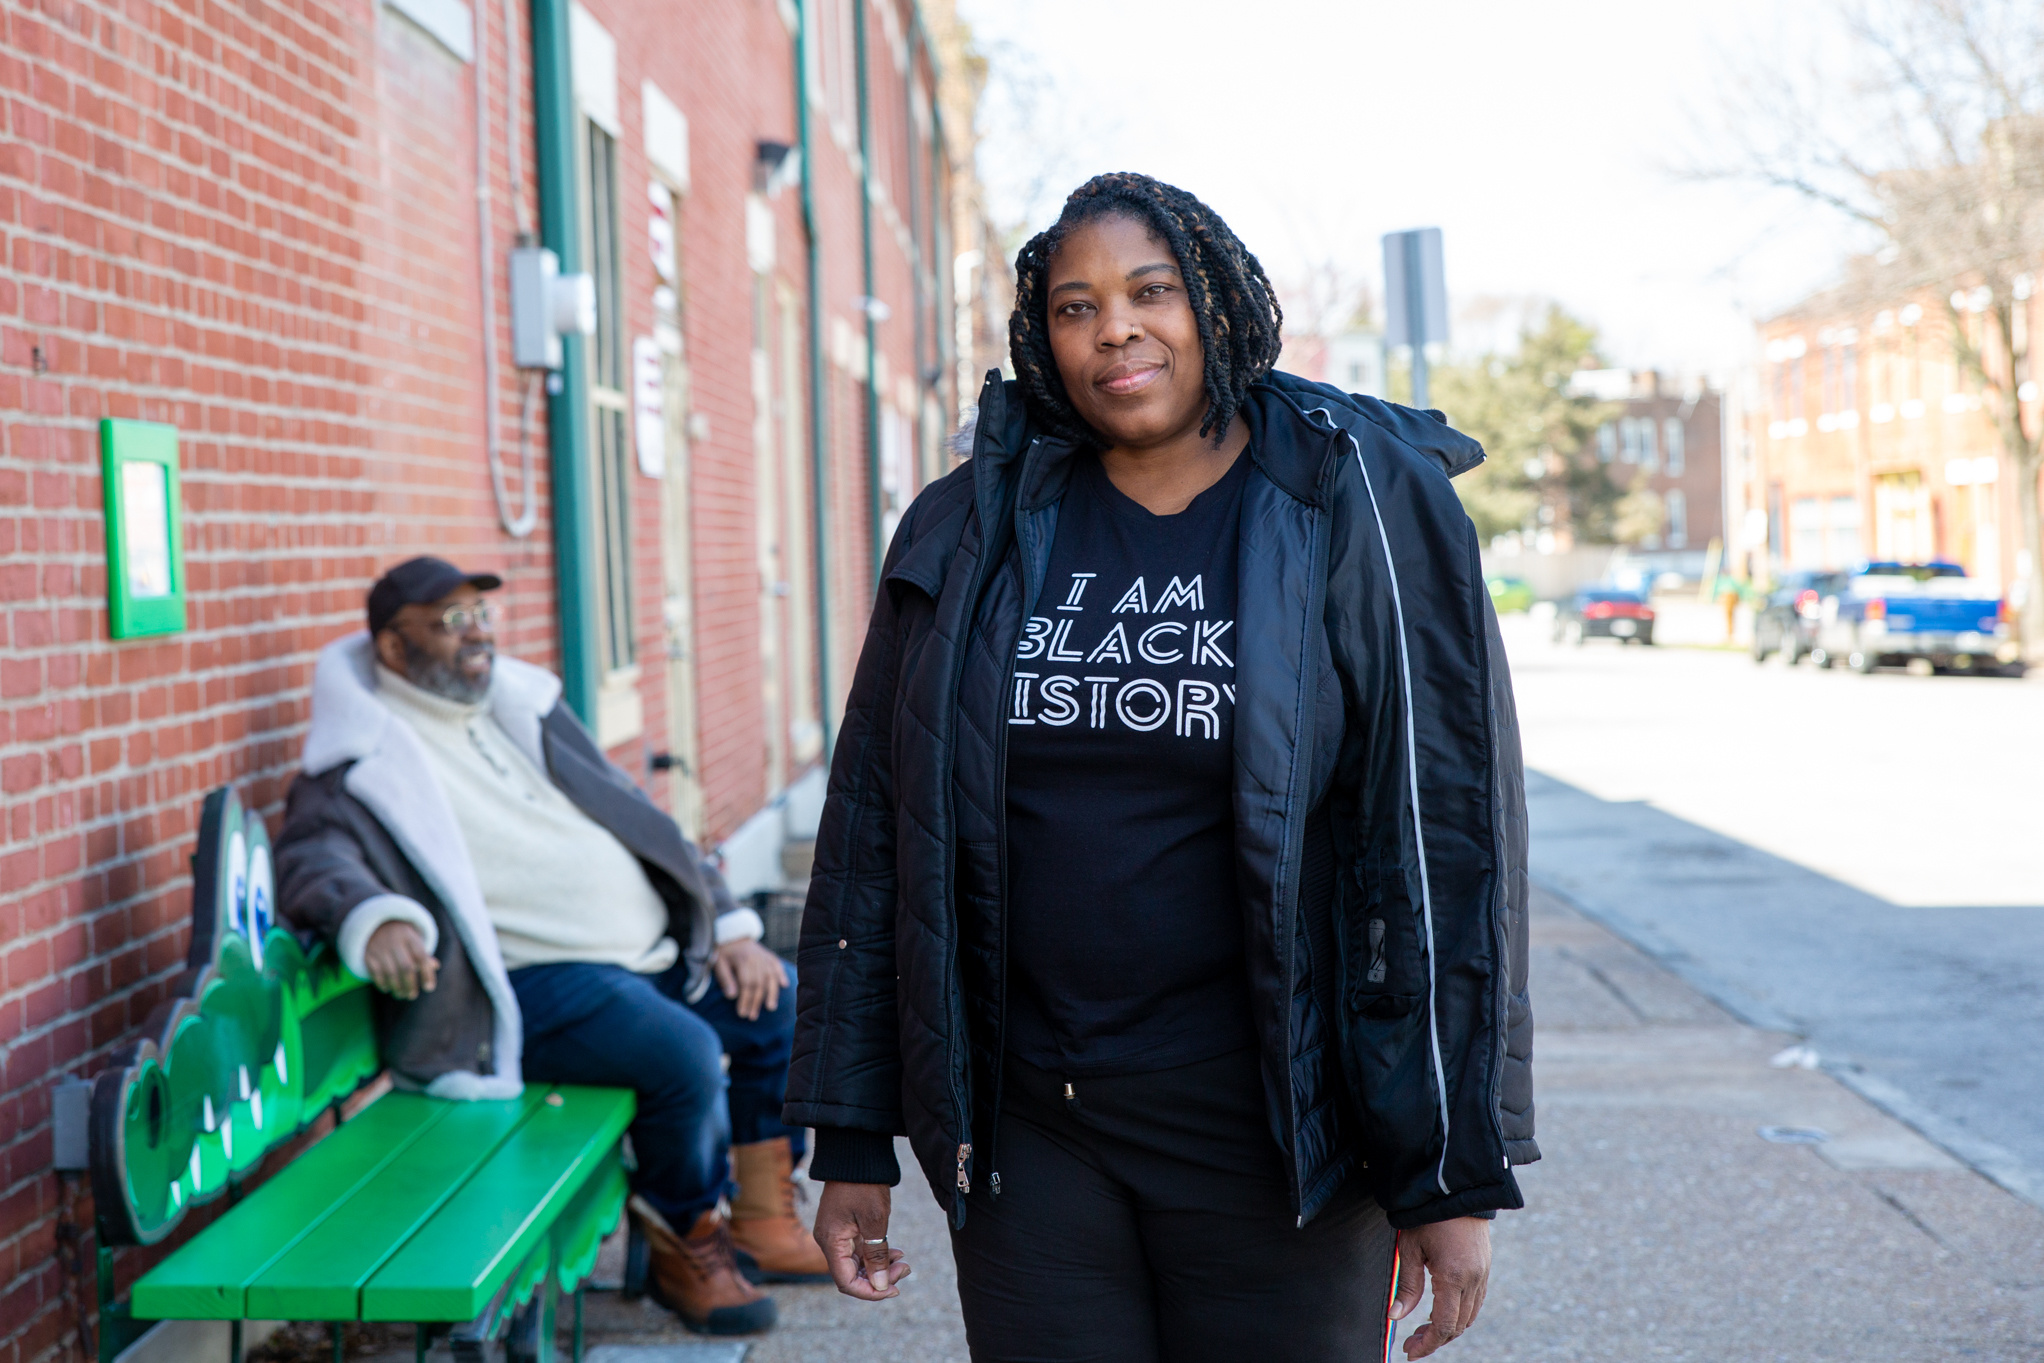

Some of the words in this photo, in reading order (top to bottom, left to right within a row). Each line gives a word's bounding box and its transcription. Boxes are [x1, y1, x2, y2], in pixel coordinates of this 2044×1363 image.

[1057, 573, 1097, 611] I
[1111, 574, 1204, 613] AM
[1017, 616, 1234, 667] BLACK
[1009, 672, 1235, 739] ISTOR
